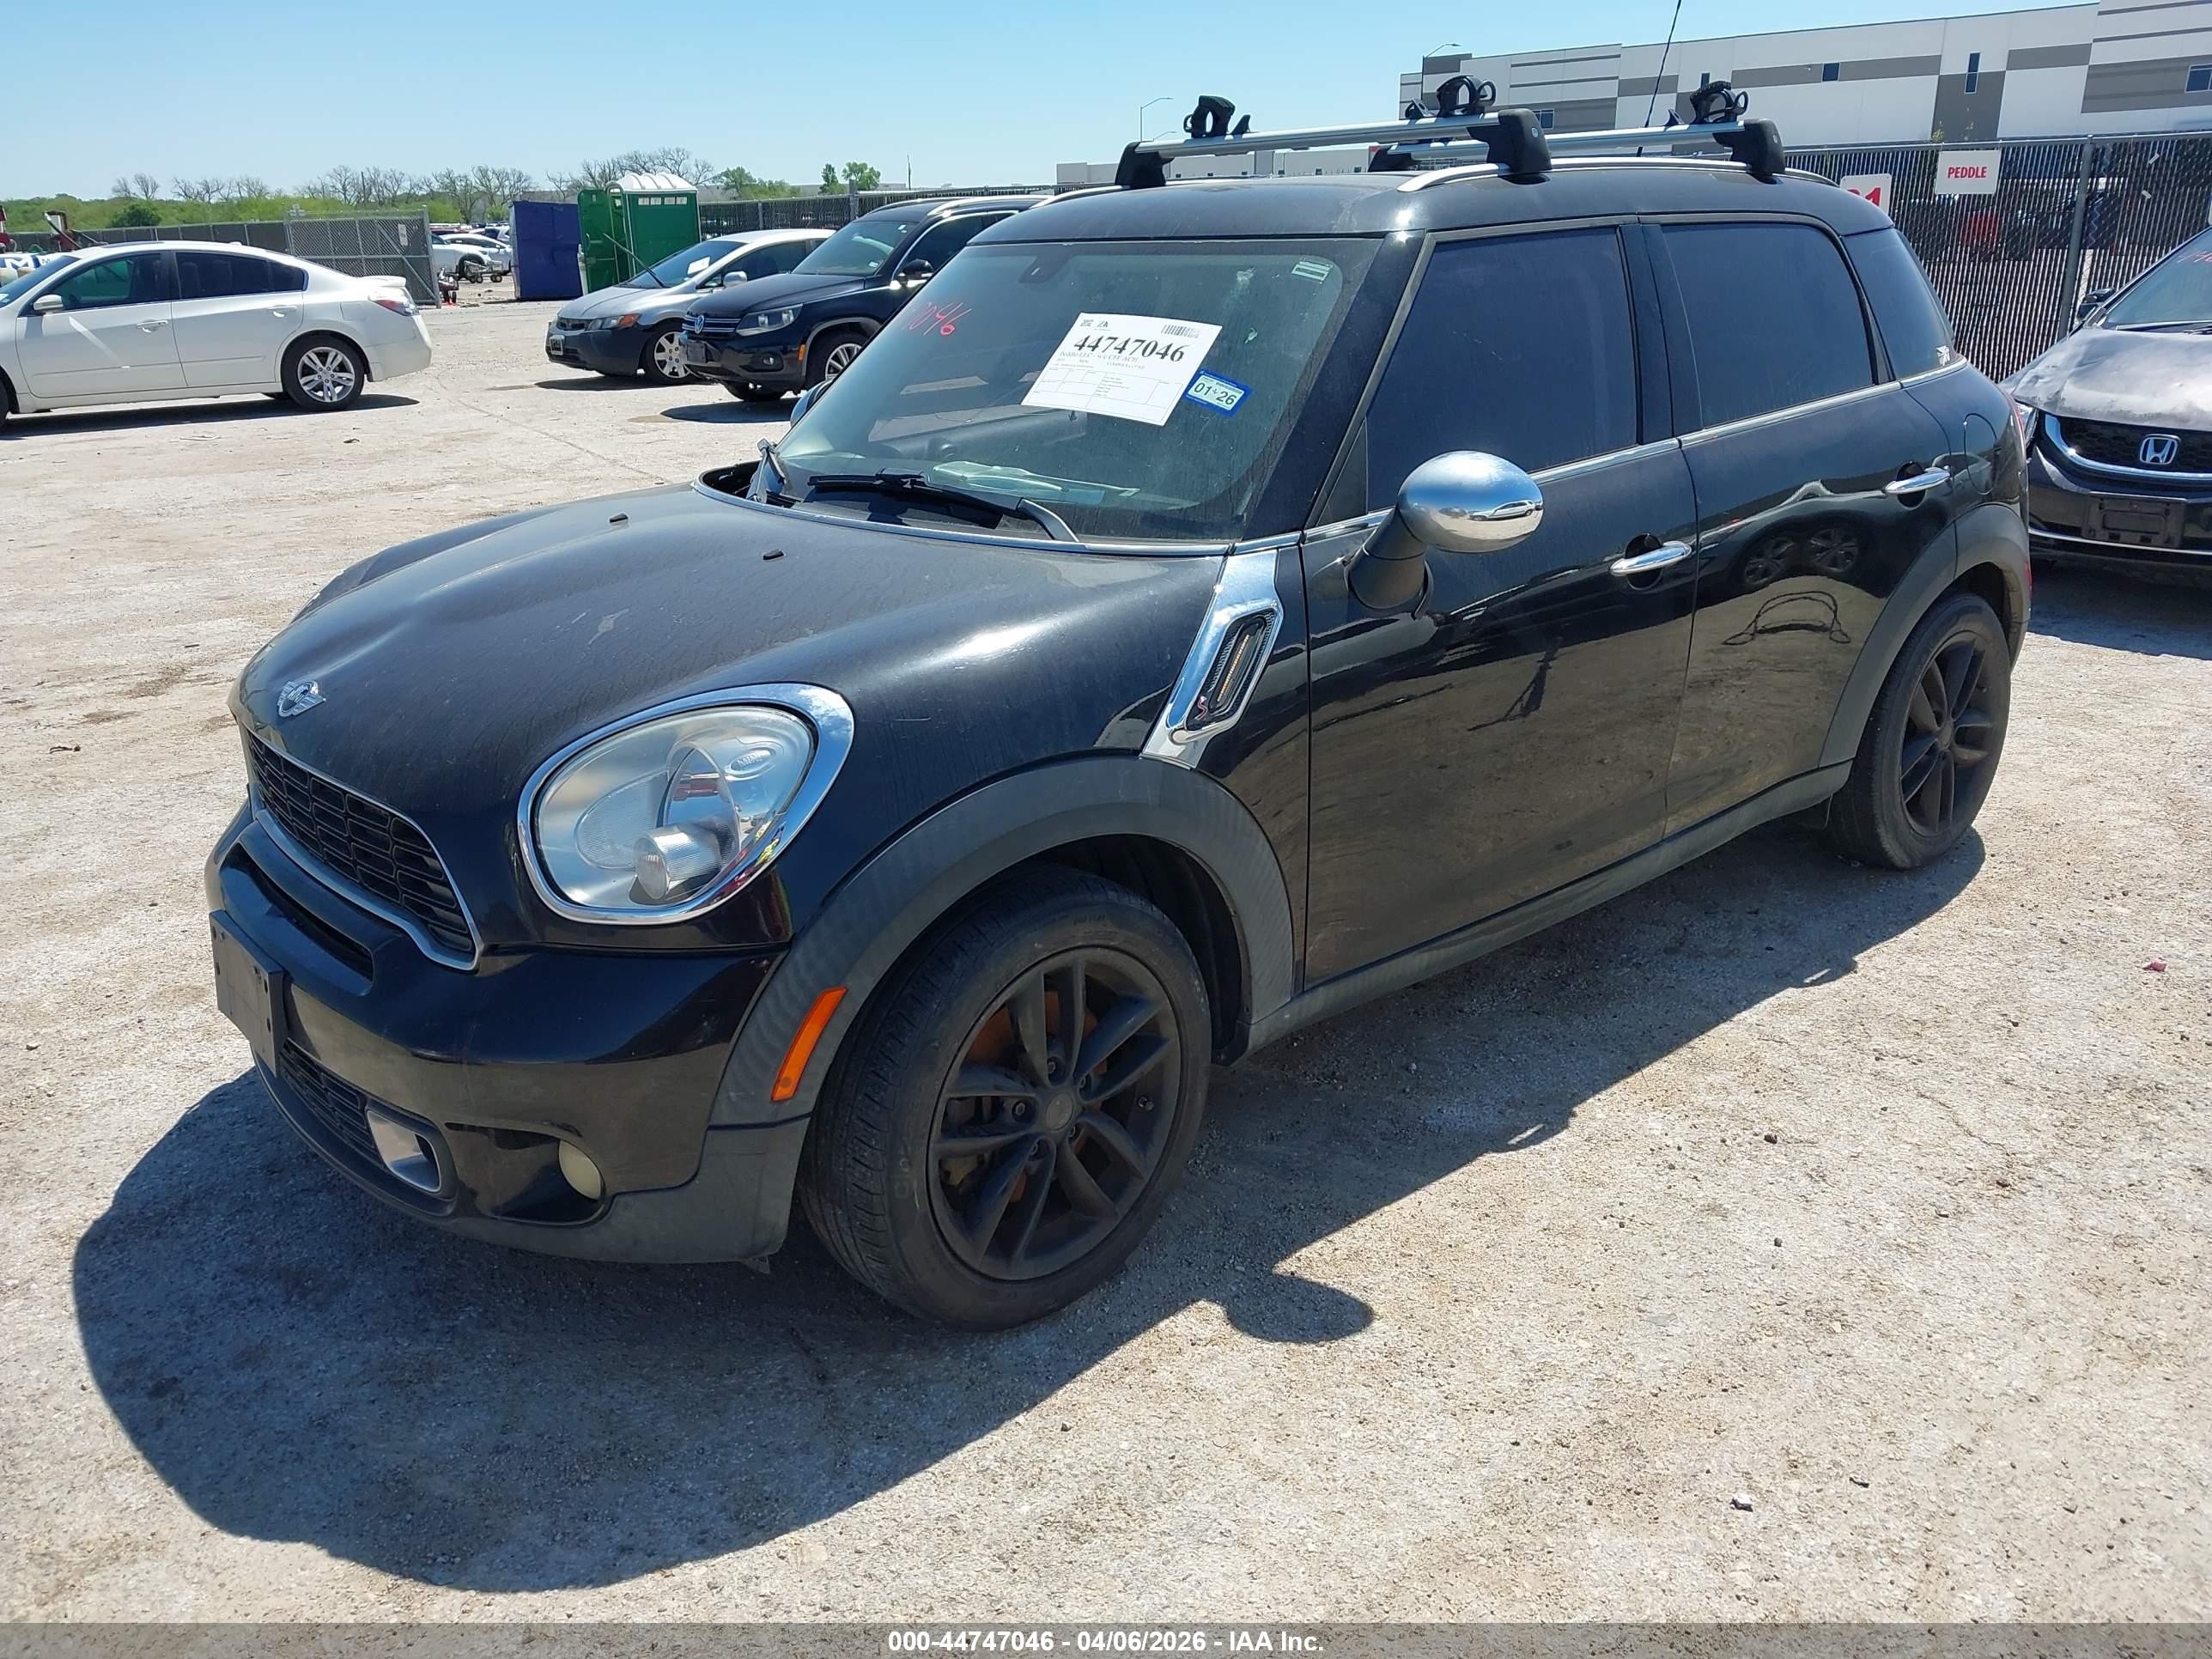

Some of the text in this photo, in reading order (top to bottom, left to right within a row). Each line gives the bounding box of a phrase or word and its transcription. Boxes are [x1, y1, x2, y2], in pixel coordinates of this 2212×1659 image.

[1948, 167, 1987, 179] PEDDLE
[1073, 335, 1190, 362] 44747046
[1194, 382, 1212, 396] 01
[1216, 391, 1237, 405] 26
